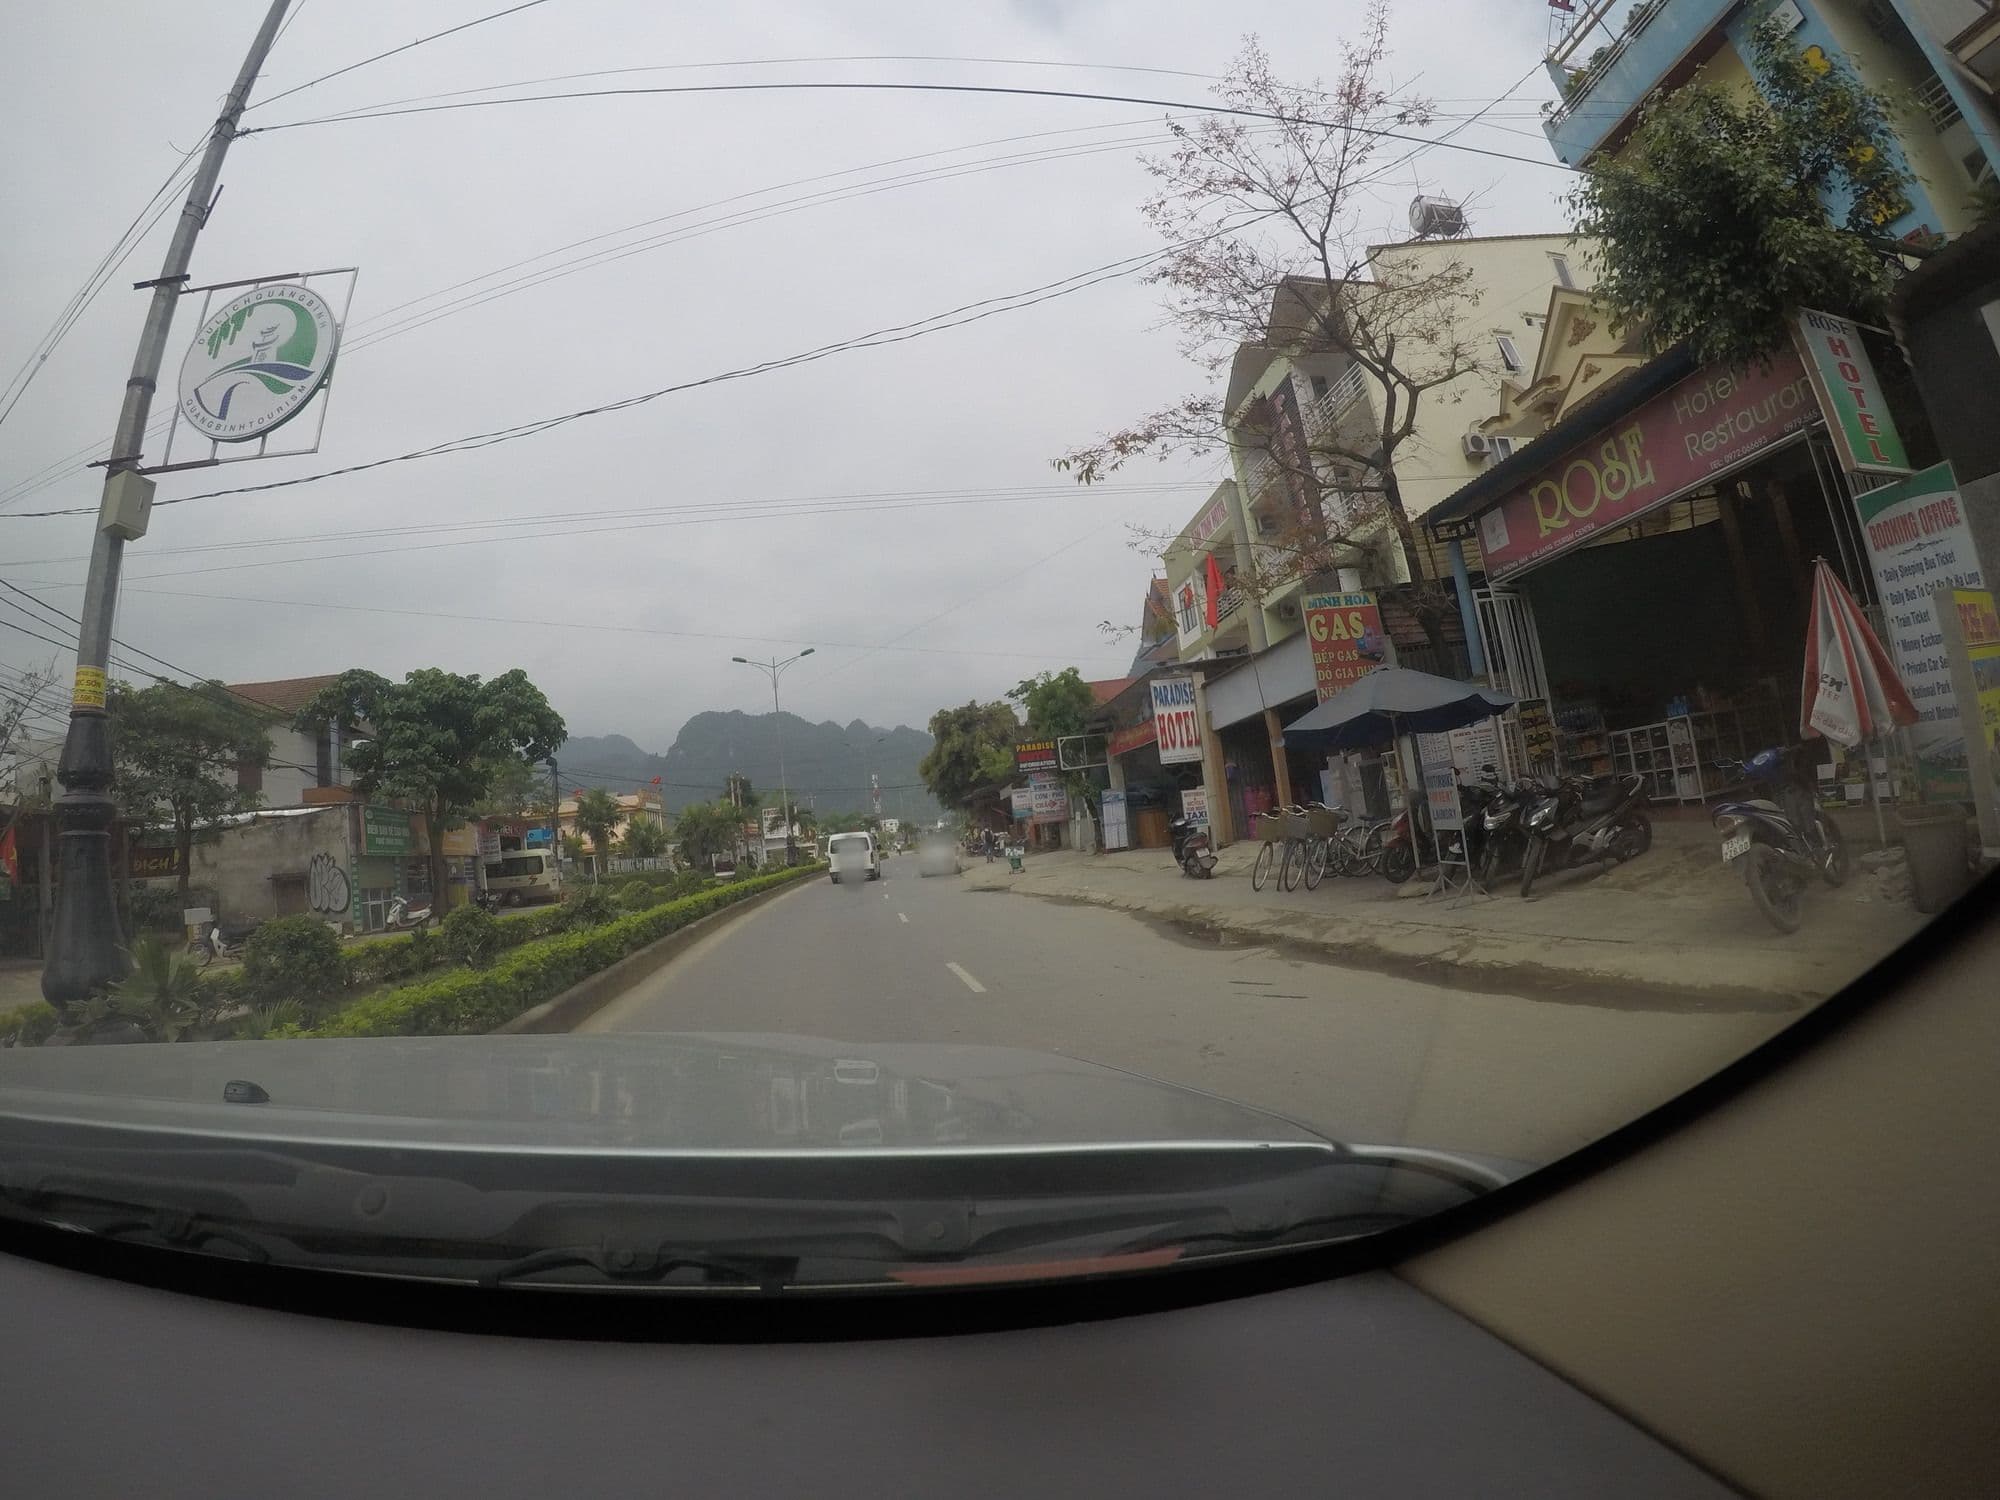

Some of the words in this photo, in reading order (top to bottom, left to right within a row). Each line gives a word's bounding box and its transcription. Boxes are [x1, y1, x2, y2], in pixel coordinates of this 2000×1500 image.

[1807, 313, 1849, 335] ROSE
[1672, 370, 1740, 425] Hotel
[1826, 336, 1890, 463] HOTEL
[1684, 376, 1810, 461] Restauran
[1529, 421, 1656, 538] ROSE
[1868, 511, 1920, 553] BOOKING
[1917, 496, 1961, 536] OFFICE
[1898, 560, 1925, 579] Sleeping
[1924, 555, 1937, 571] Bus
[1935, 550, 1957, 567] Ticket
[1905, 586, 1918, 602] Bus
[1964, 570, 1981, 585] Long
[1308, 596, 1341, 609] MINH
[1309, 611, 1365, 642] GAS
[1895, 614, 1912, 629] Train
[1910, 609, 1931, 625] Ticket
[1900, 638, 1921, 653] Money
[1920, 632, 1943, 649] Exchan
[1337, 649, 1359, 662] GAS
[1906, 660, 1928, 676] Private
[1927, 657, 1940, 673] Car
[1939, 655, 1949, 670] Se
[1335, 667, 1355, 680] GIA
[1153, 681, 1195, 708] PARADISE
[1911, 683, 1937, 700] National
[1936, 680, 1953, 696] Park
[1920, 707, 1937, 721] ental
[1157, 710, 1201, 751] HOTEL
[1015, 741, 1055, 753] PARADISE
[1186, 810, 1208, 820] TAXI
